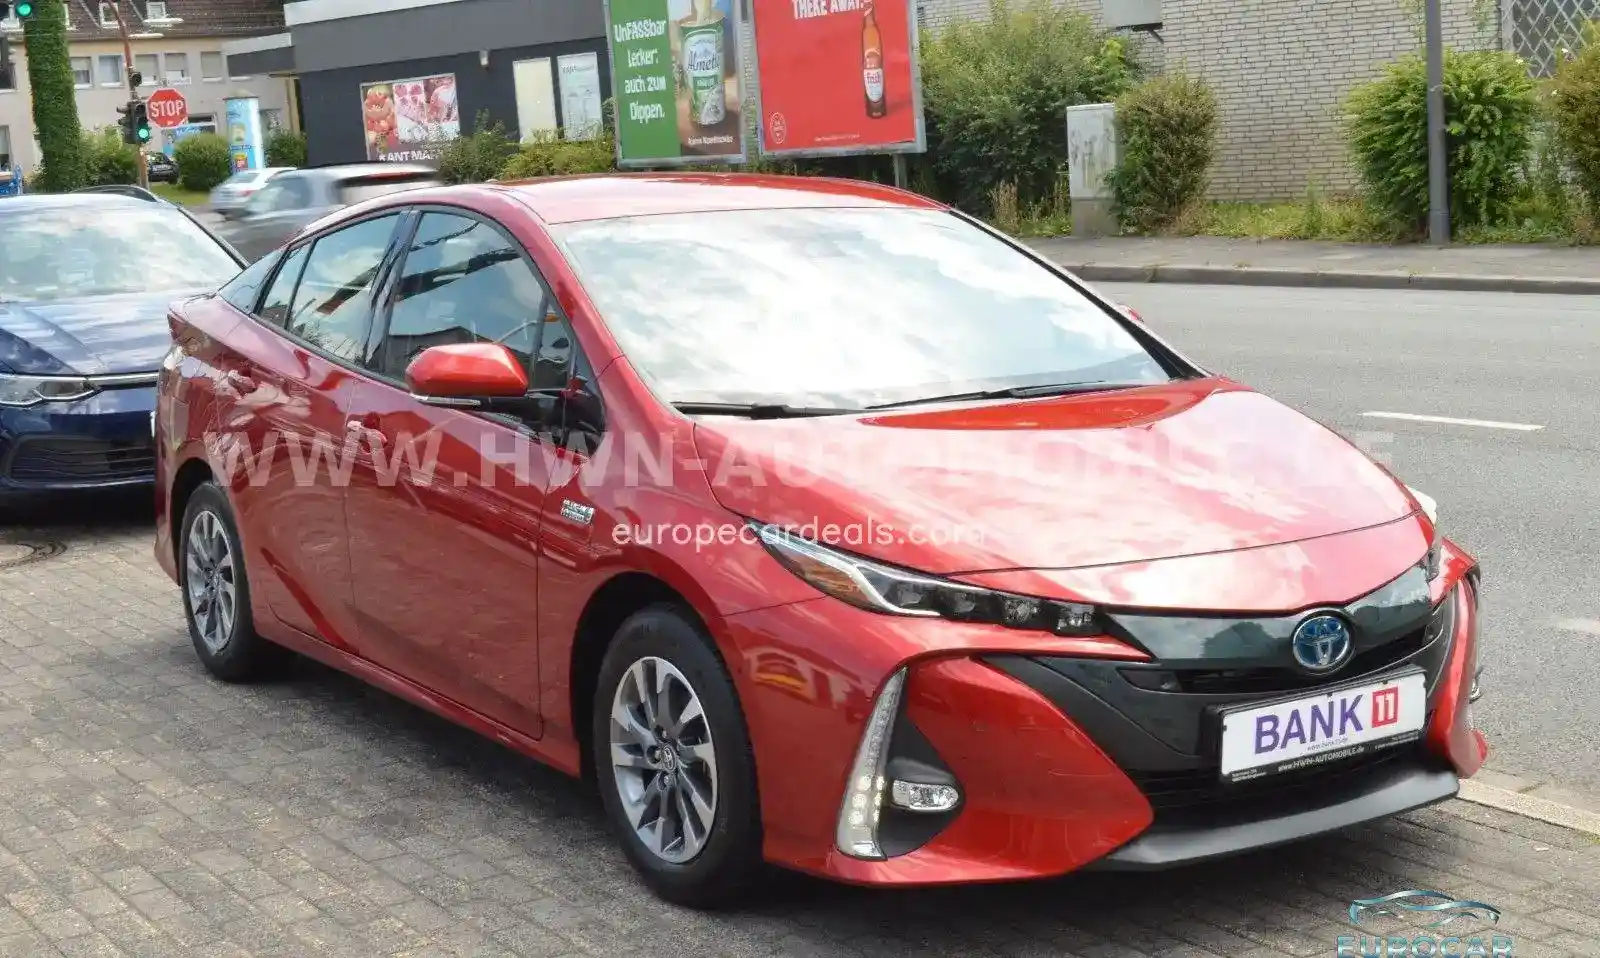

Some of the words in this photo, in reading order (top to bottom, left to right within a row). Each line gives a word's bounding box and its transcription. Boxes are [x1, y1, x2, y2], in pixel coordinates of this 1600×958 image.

[151, 100, 184, 118] STOP
[629, 101, 665, 124] Dippen.
[1254, 694, 1364, 755] BANK
[1375, 691, 1396, 722] 11
